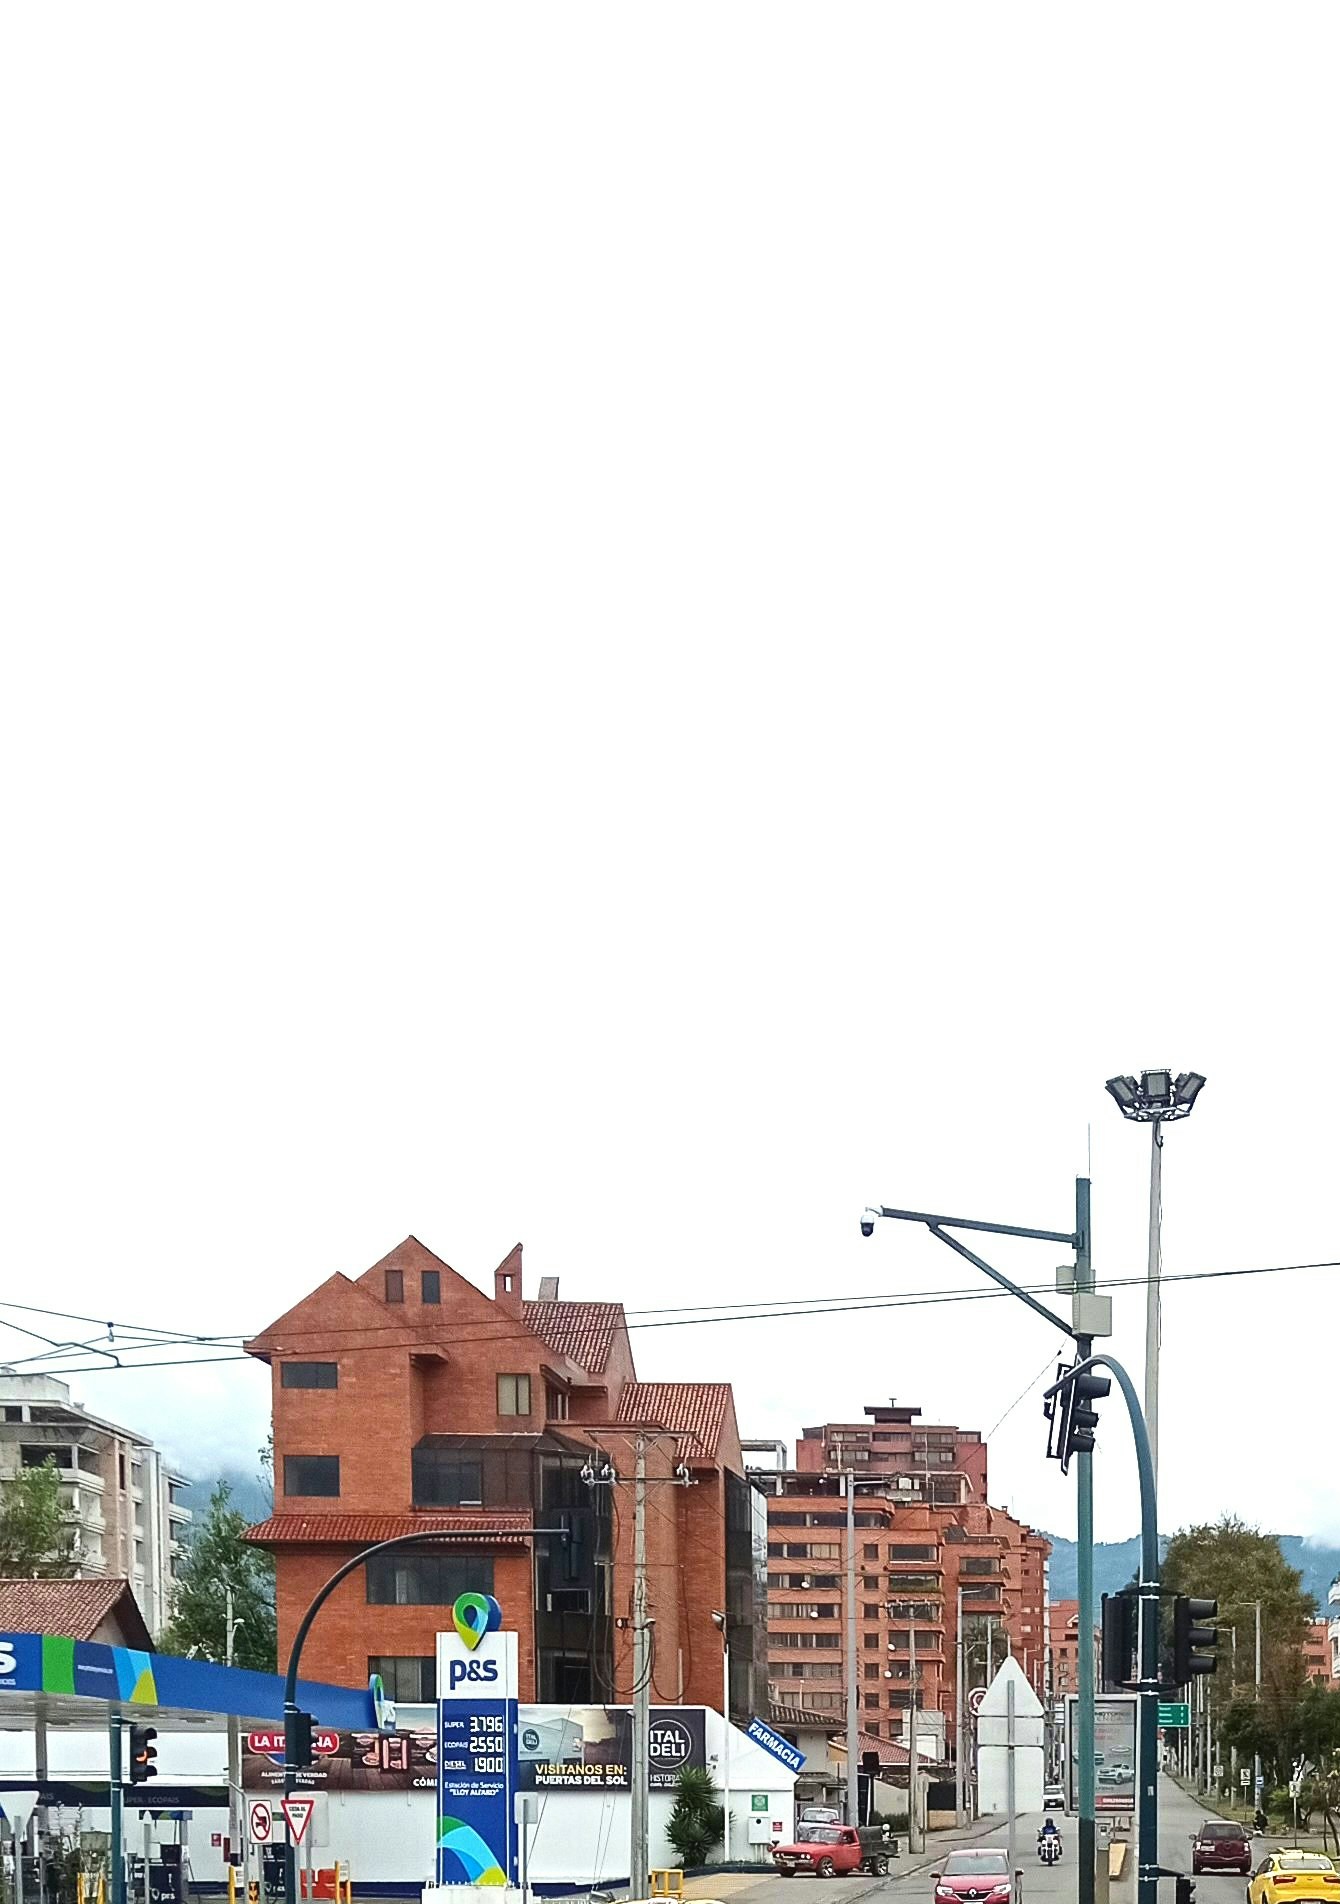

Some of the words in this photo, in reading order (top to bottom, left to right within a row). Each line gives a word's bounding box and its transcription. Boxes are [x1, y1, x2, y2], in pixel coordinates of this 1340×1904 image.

[450, 1660, 498, 1690] p&s
[254, 1736, 270, 1747] LA
[650, 1730, 686, 1743] ITAL
[650, 1744, 685, 1757] DELI
[749, 1723, 800, 1768] FARMACIA
[535, 1764, 602, 1775] VISITANOS
[606, 1764, 627, 1775] EN:
[536, 1776, 582, 1785] PUERTAS
[584, 1776, 604, 1785] DEL
[606, 1776, 628, 1785] SOL
